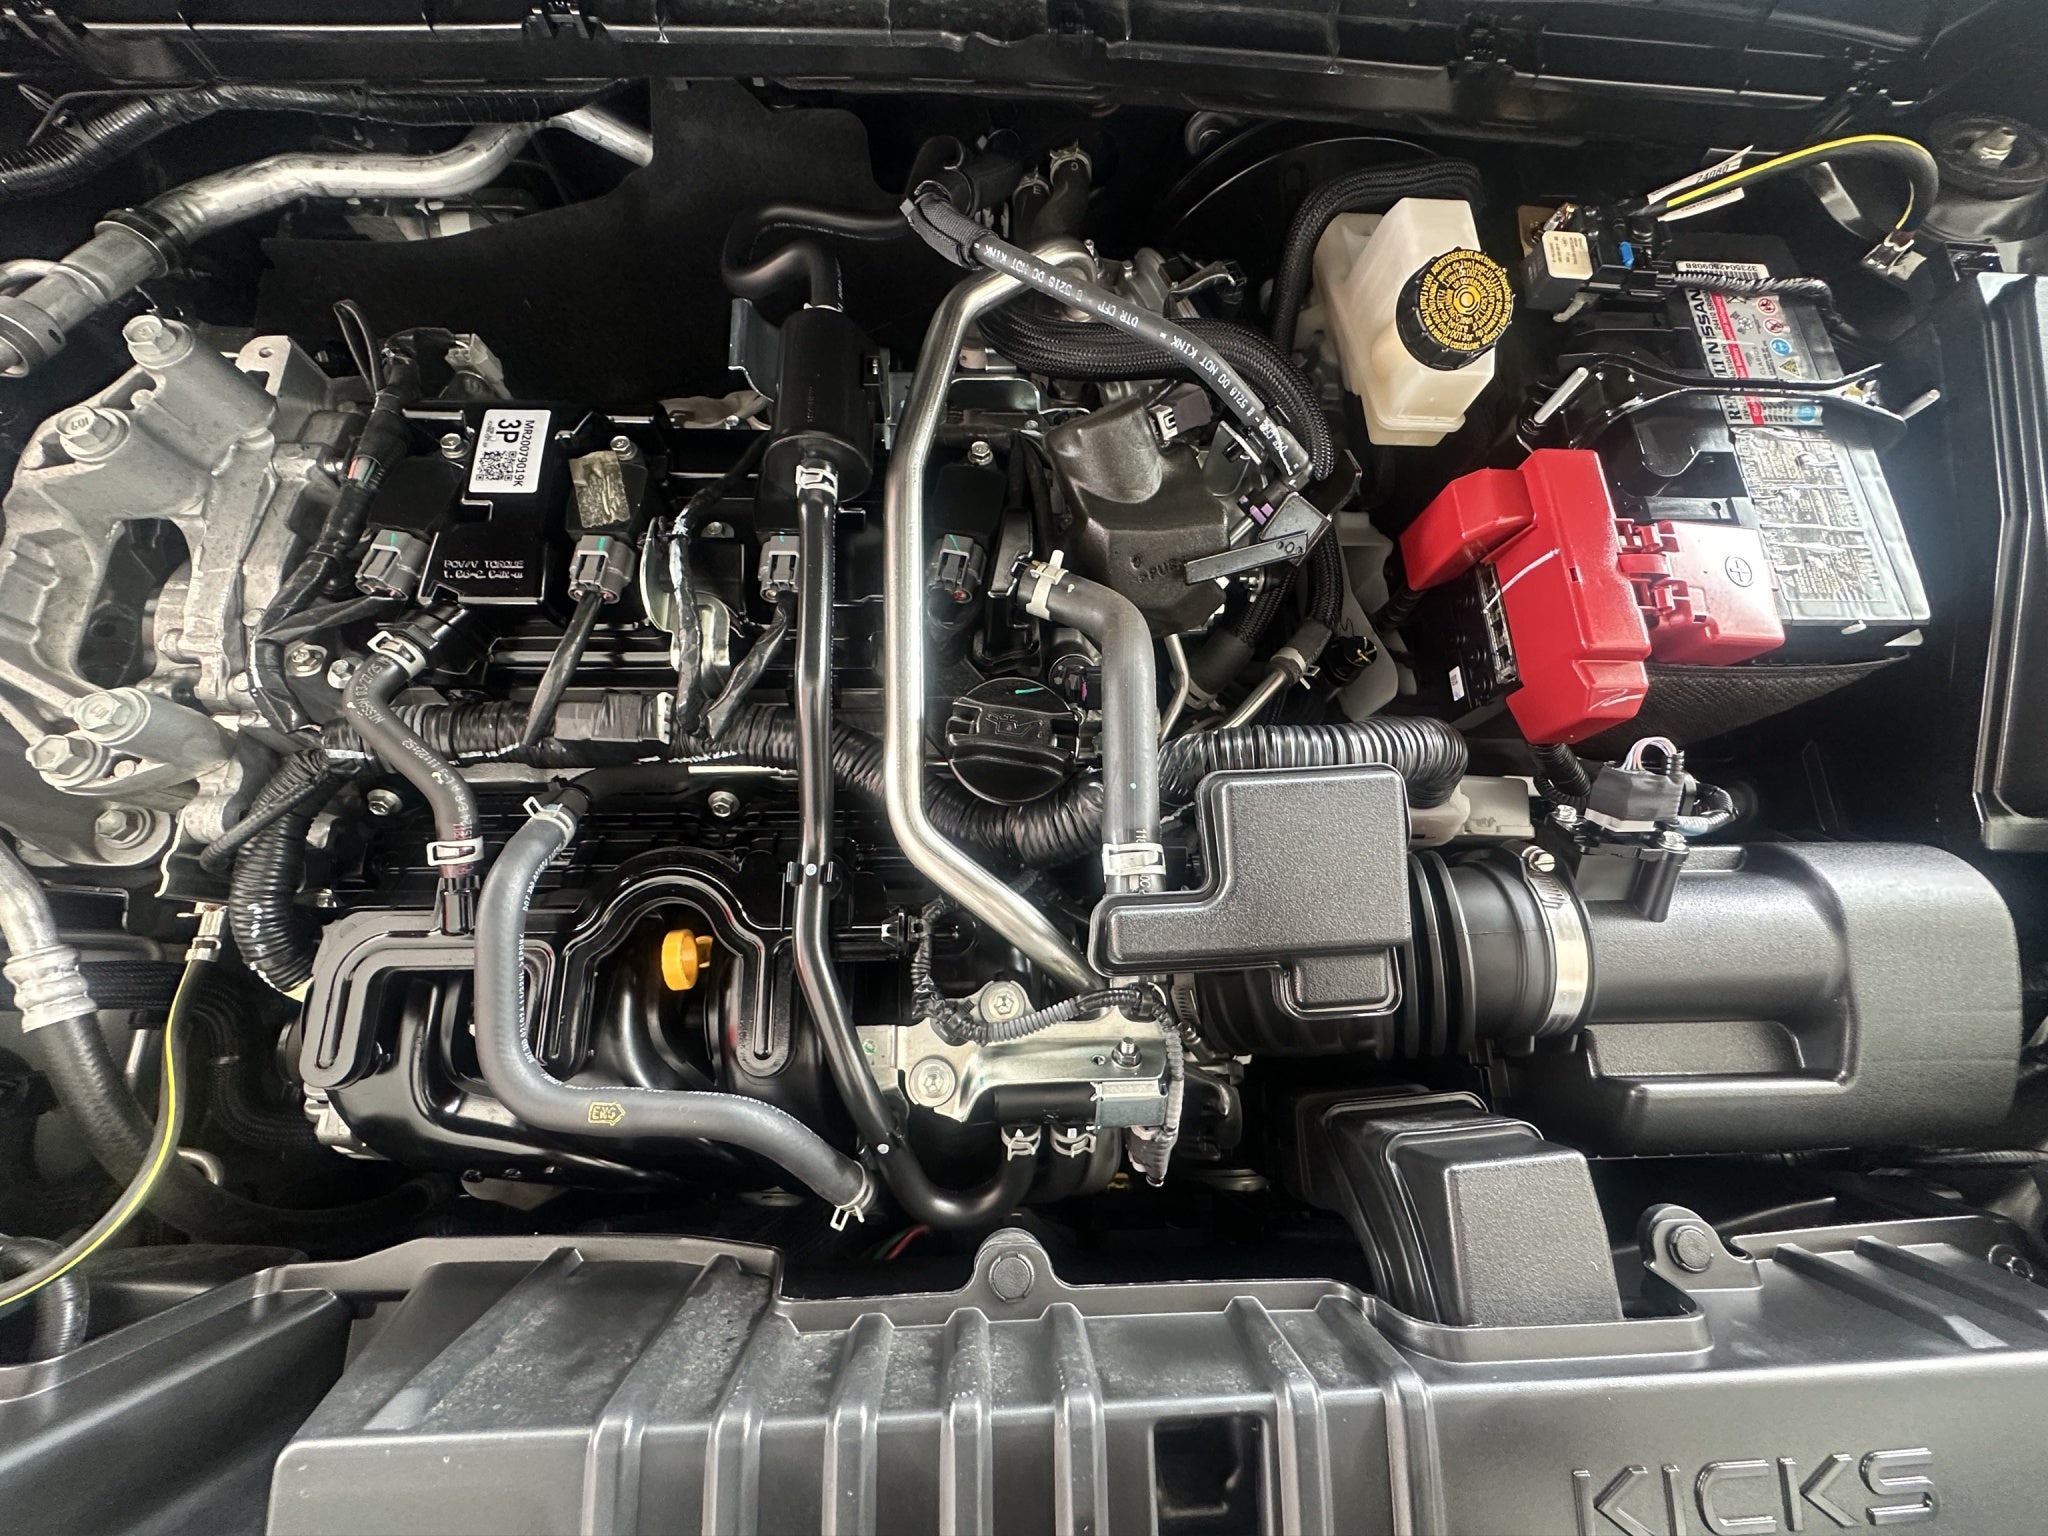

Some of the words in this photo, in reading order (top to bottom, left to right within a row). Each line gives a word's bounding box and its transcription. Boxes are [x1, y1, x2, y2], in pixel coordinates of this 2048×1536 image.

[984, 245, 1007, 263] KINK
[1032, 268, 1046, 282] DO
[1097, 301, 1115, 316] CFP
[1119, 310, 1139, 327] DTR
[1688, 289, 1721, 354] NISSAN
[1170, 335, 1199, 358] KINK
[1199, 356, 1219, 375] NOT
[1752, 346, 1765, 374] CLARIOS
[1217, 373, 1231, 388] DO
[496, 420, 522, 444] 3P
[513, 420, 534, 487] MR20079019K
[484, 560, 524, 568] TORQUE
[357, 698, 385, 723] NISSAN
[402, 738, 440, 768] 11:22:52
[523, 895, 531, 911] DOT
[592, 1104, 616, 1120] ENG
[1572, 1447, 1940, 1536] KICKS
